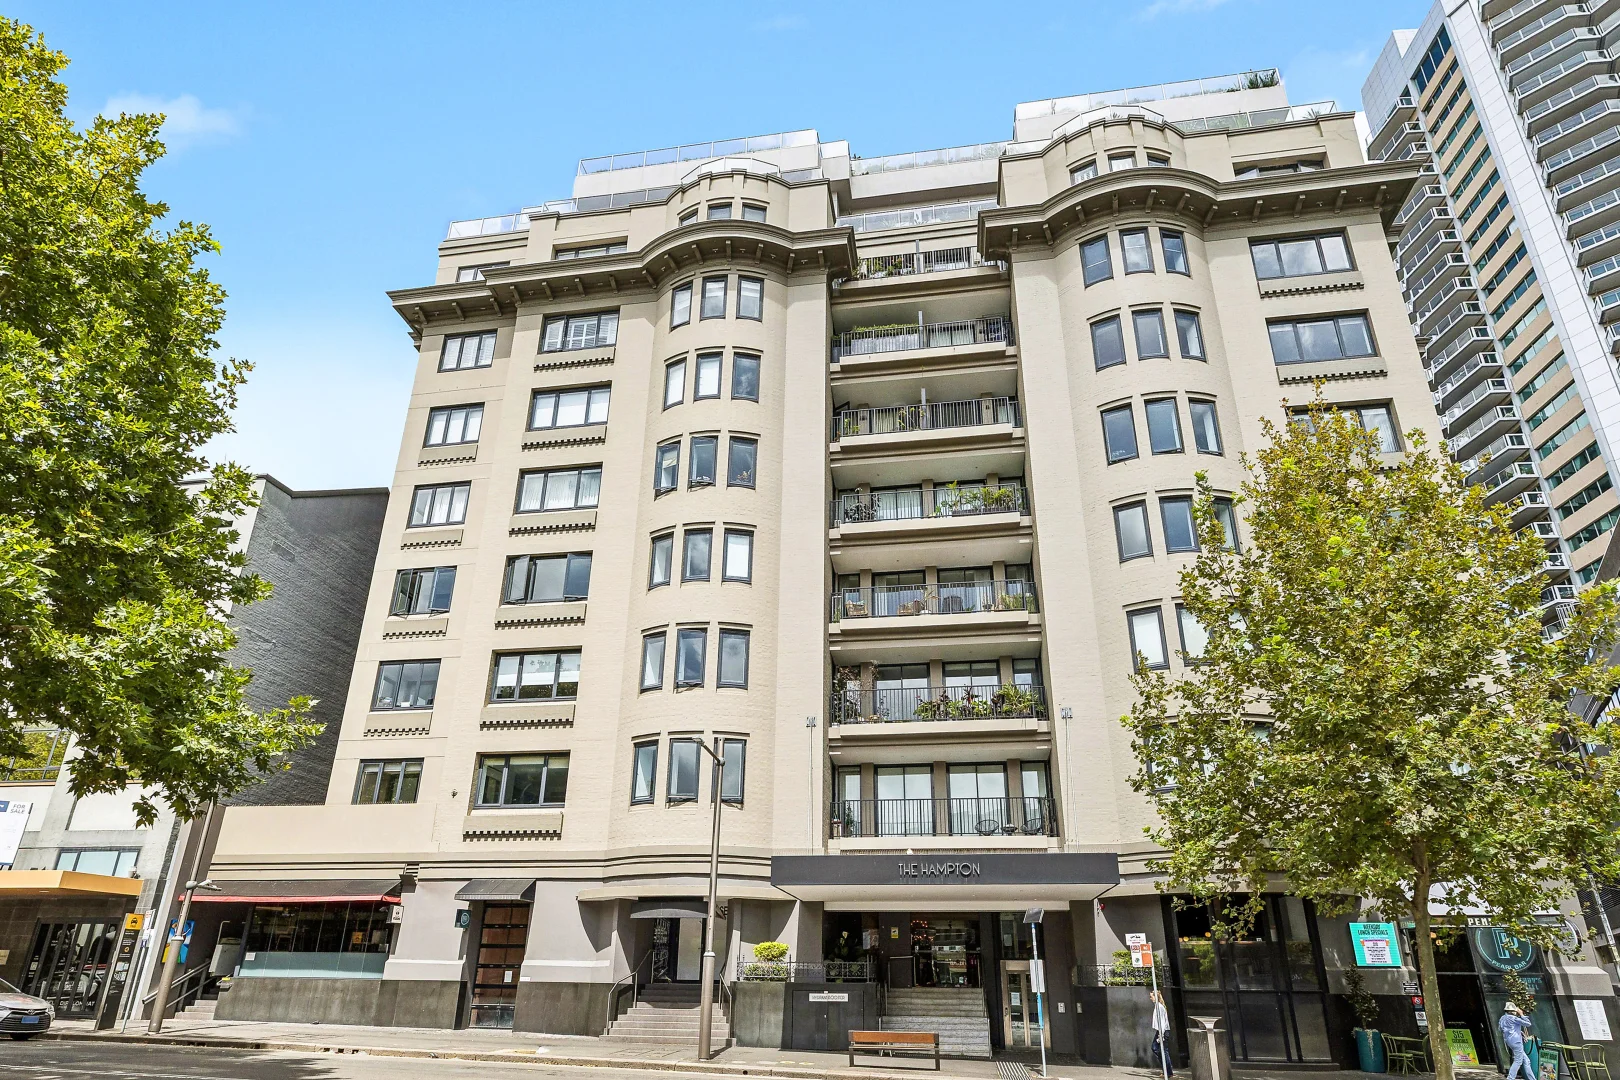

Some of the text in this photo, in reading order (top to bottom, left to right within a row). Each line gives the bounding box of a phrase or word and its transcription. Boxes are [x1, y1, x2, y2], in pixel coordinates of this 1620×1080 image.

[898, 863, 981, 876] THE HAMPTON
[1514, 961, 1527, 970] BAR
[1452, 1030, 1465, 1039] $15
